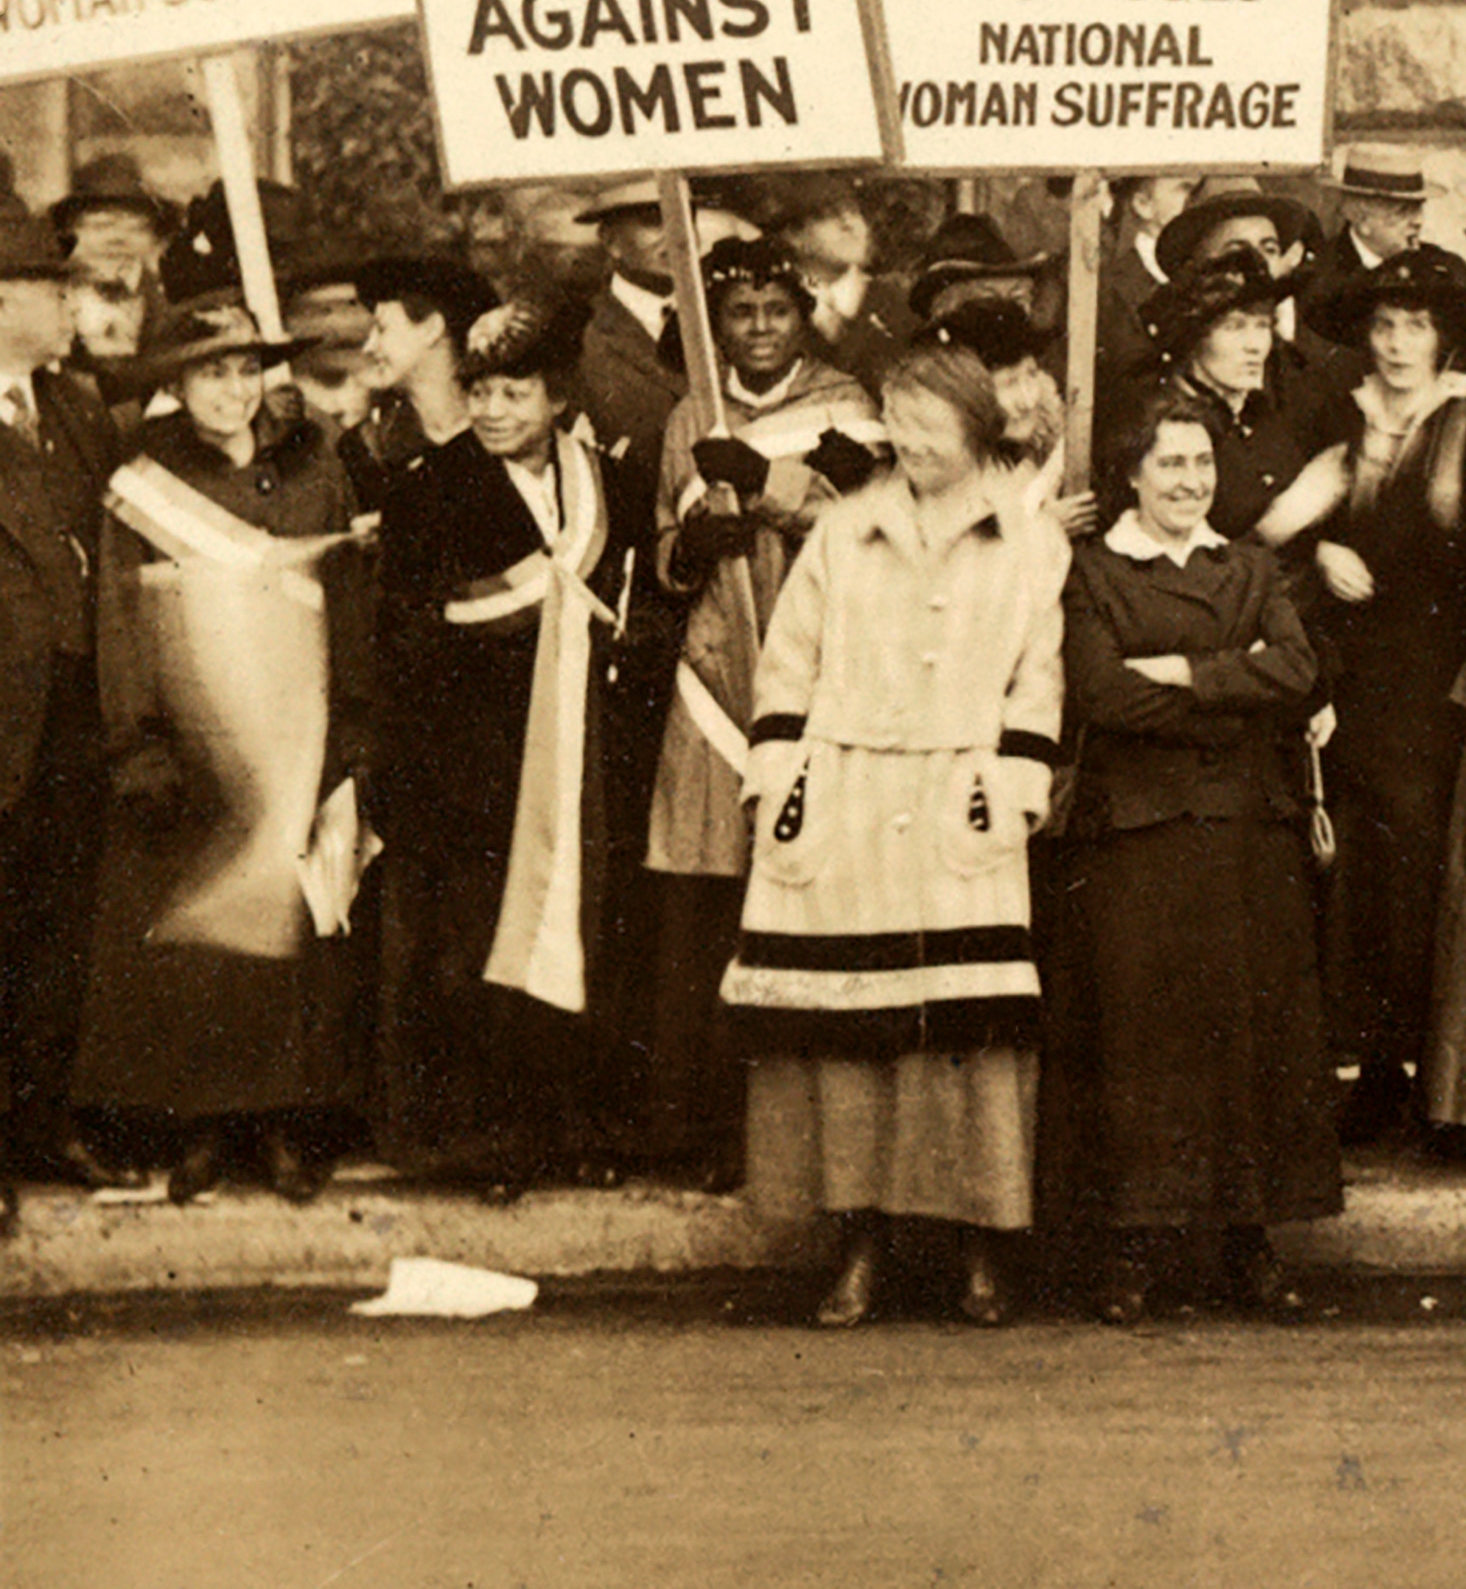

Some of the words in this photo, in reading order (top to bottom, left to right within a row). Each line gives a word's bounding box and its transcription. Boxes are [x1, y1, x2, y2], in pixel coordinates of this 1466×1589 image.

[979, 22, 1213, 68] NATIONAL
[495, 56, 799, 141] WOMEN
[1051, 81, 1300, 130] SUFFRAGE
